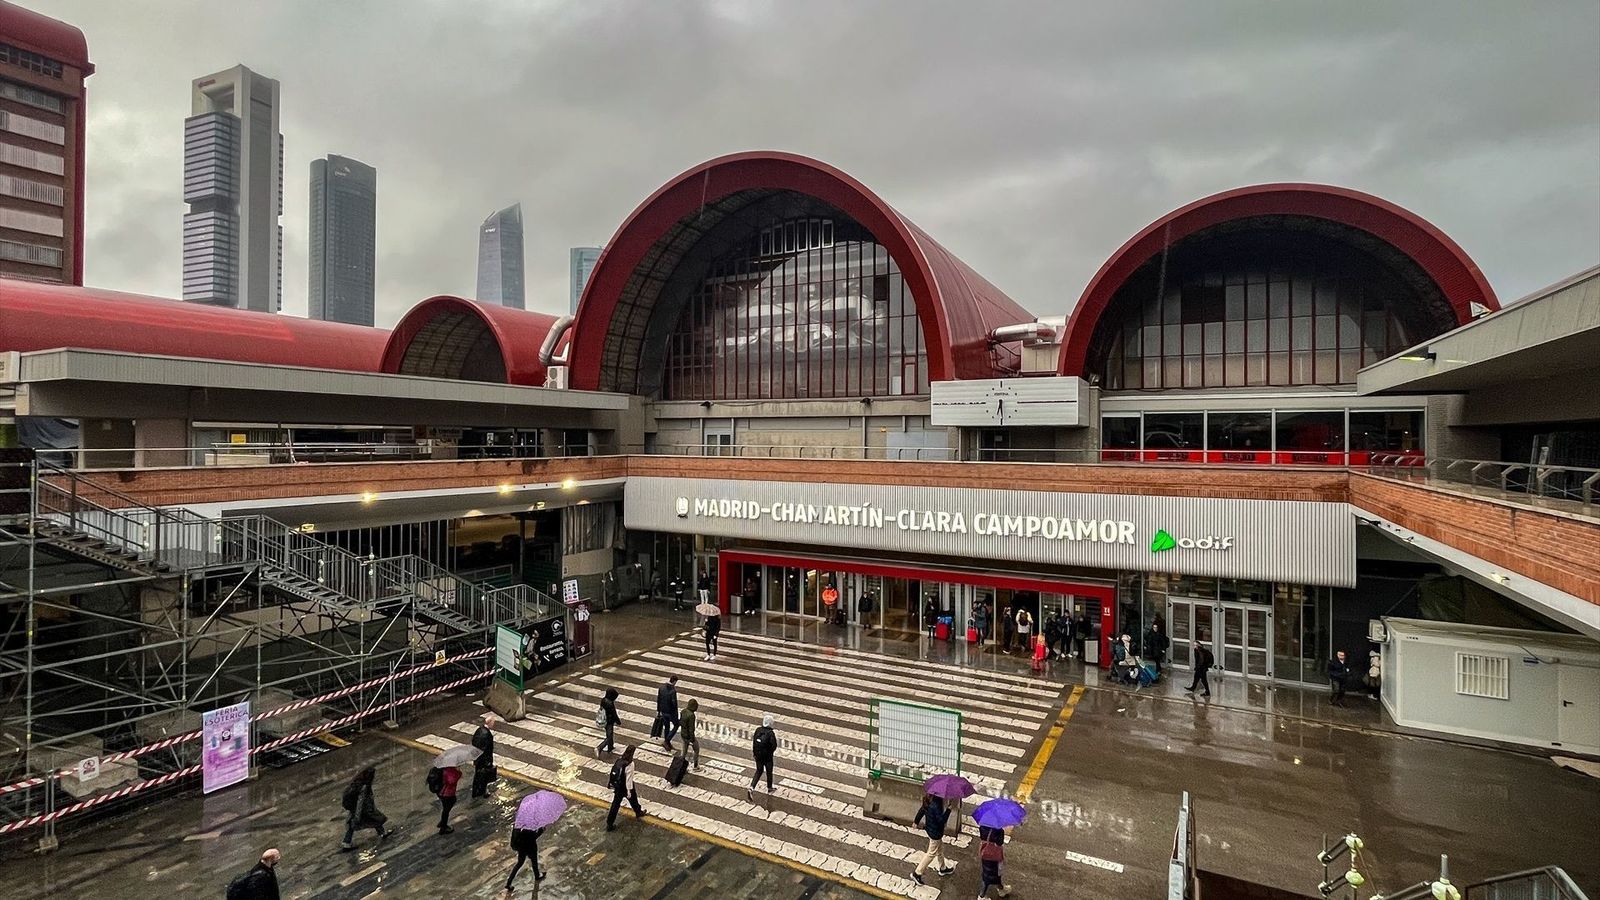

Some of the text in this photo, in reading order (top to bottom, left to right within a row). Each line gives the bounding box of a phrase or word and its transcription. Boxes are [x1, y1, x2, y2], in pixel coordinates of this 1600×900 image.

[973, 512, 1136, 545] CAMPOAMOR
[1178, 535, 1234, 550] adif
[216, 707, 238, 716] FERIA
